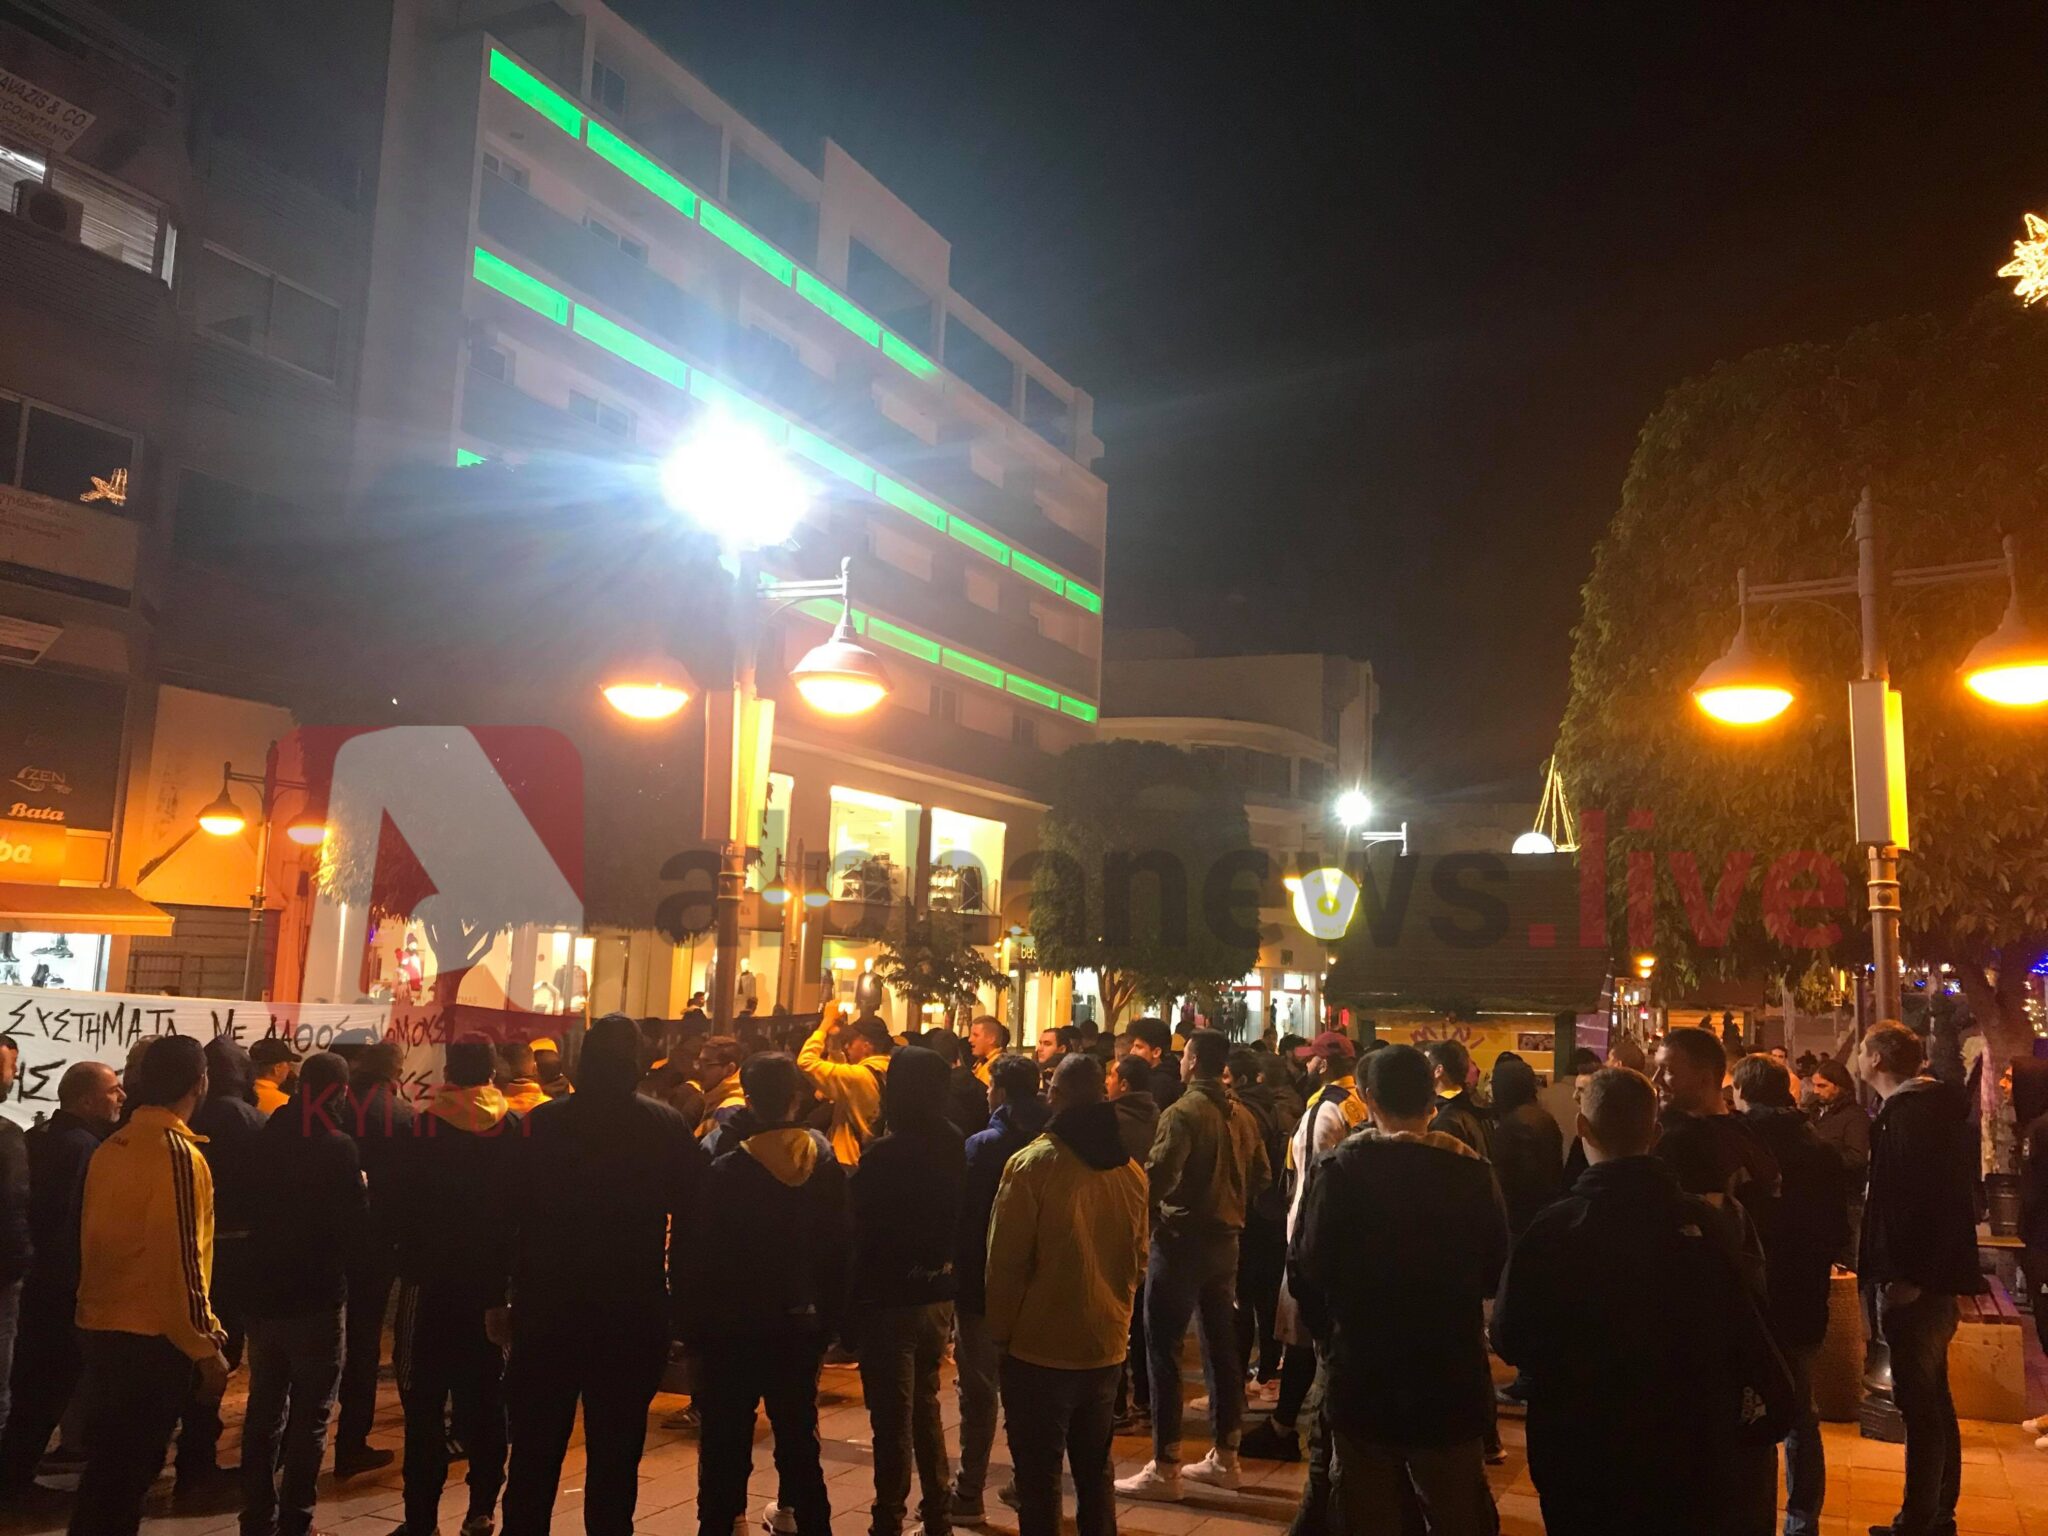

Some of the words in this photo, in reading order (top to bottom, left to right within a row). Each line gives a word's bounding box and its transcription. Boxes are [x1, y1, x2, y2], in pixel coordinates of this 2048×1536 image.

[47, 100, 61, 115] &
[0, 99, 75, 141] COUNTANTS
[7, 803, 65, 821] Bata
